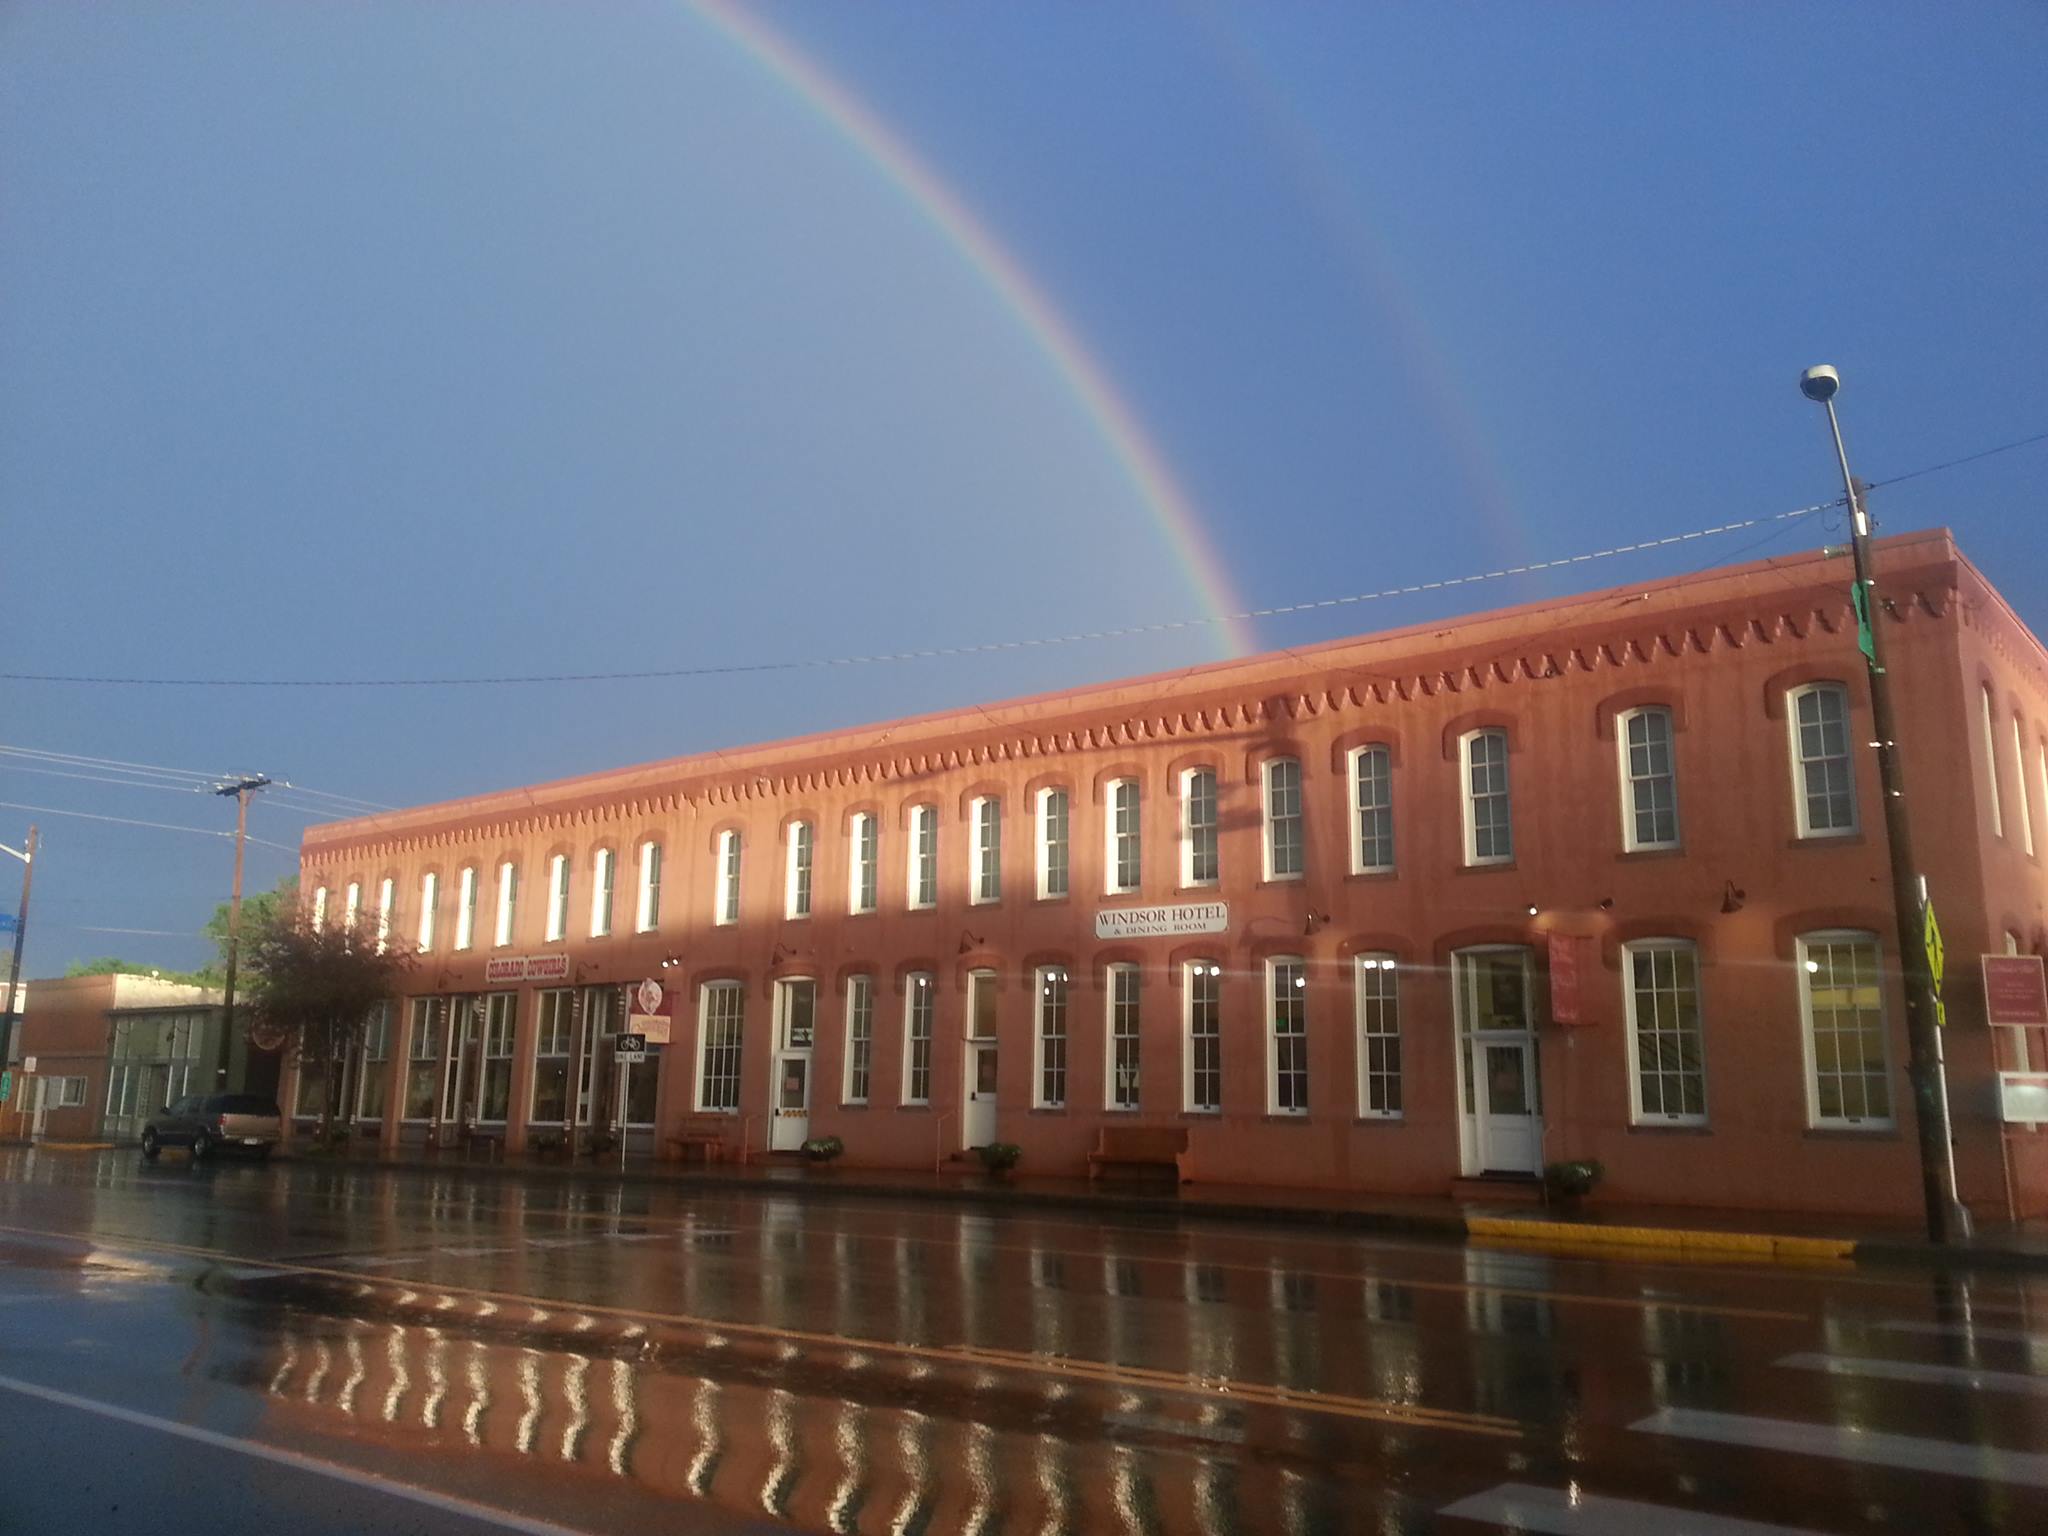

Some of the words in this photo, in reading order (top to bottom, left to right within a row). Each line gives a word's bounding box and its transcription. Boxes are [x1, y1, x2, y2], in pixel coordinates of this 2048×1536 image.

[1100, 909, 1166, 926] WINDSOR
[1172, 905, 1225, 921] HOTEL
[1126, 925, 1167, 934] DINING
[1174, 922, 1207, 931] ROOM
[489, 961, 524, 978] COLORADO
